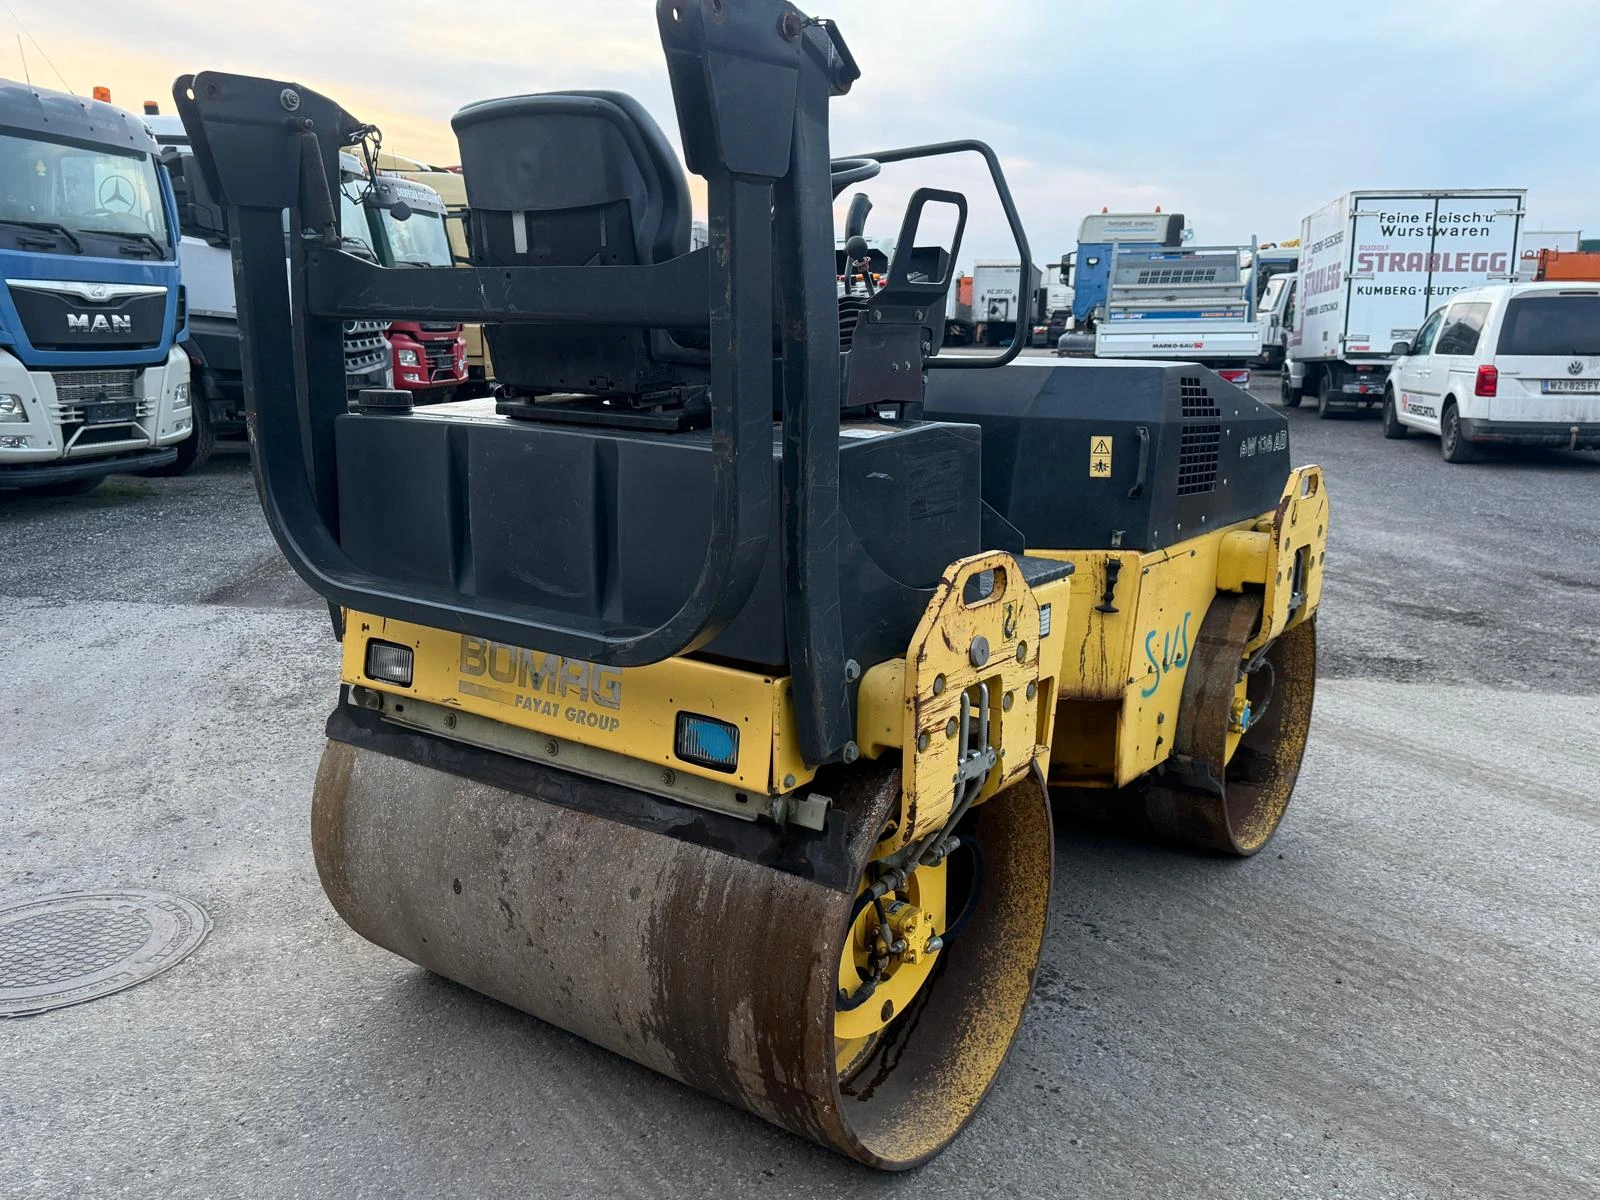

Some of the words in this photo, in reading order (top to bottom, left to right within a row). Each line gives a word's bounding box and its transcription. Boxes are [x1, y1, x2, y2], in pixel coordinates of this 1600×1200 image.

[1379, 212, 1419, 224] Feine
[1381, 225, 1490, 237] Wurstwaren
[1357, 252, 1508, 273] STRABLEGG
[66, 313, 131, 332] MAN
[1550, 380, 1564, 390] WZ
[1141, 611, 1191, 698] SUS
[459, 634, 623, 710] BOMAG
[515, 694, 560, 718] FAYAT
[564, 706, 620, 732] GROUP
